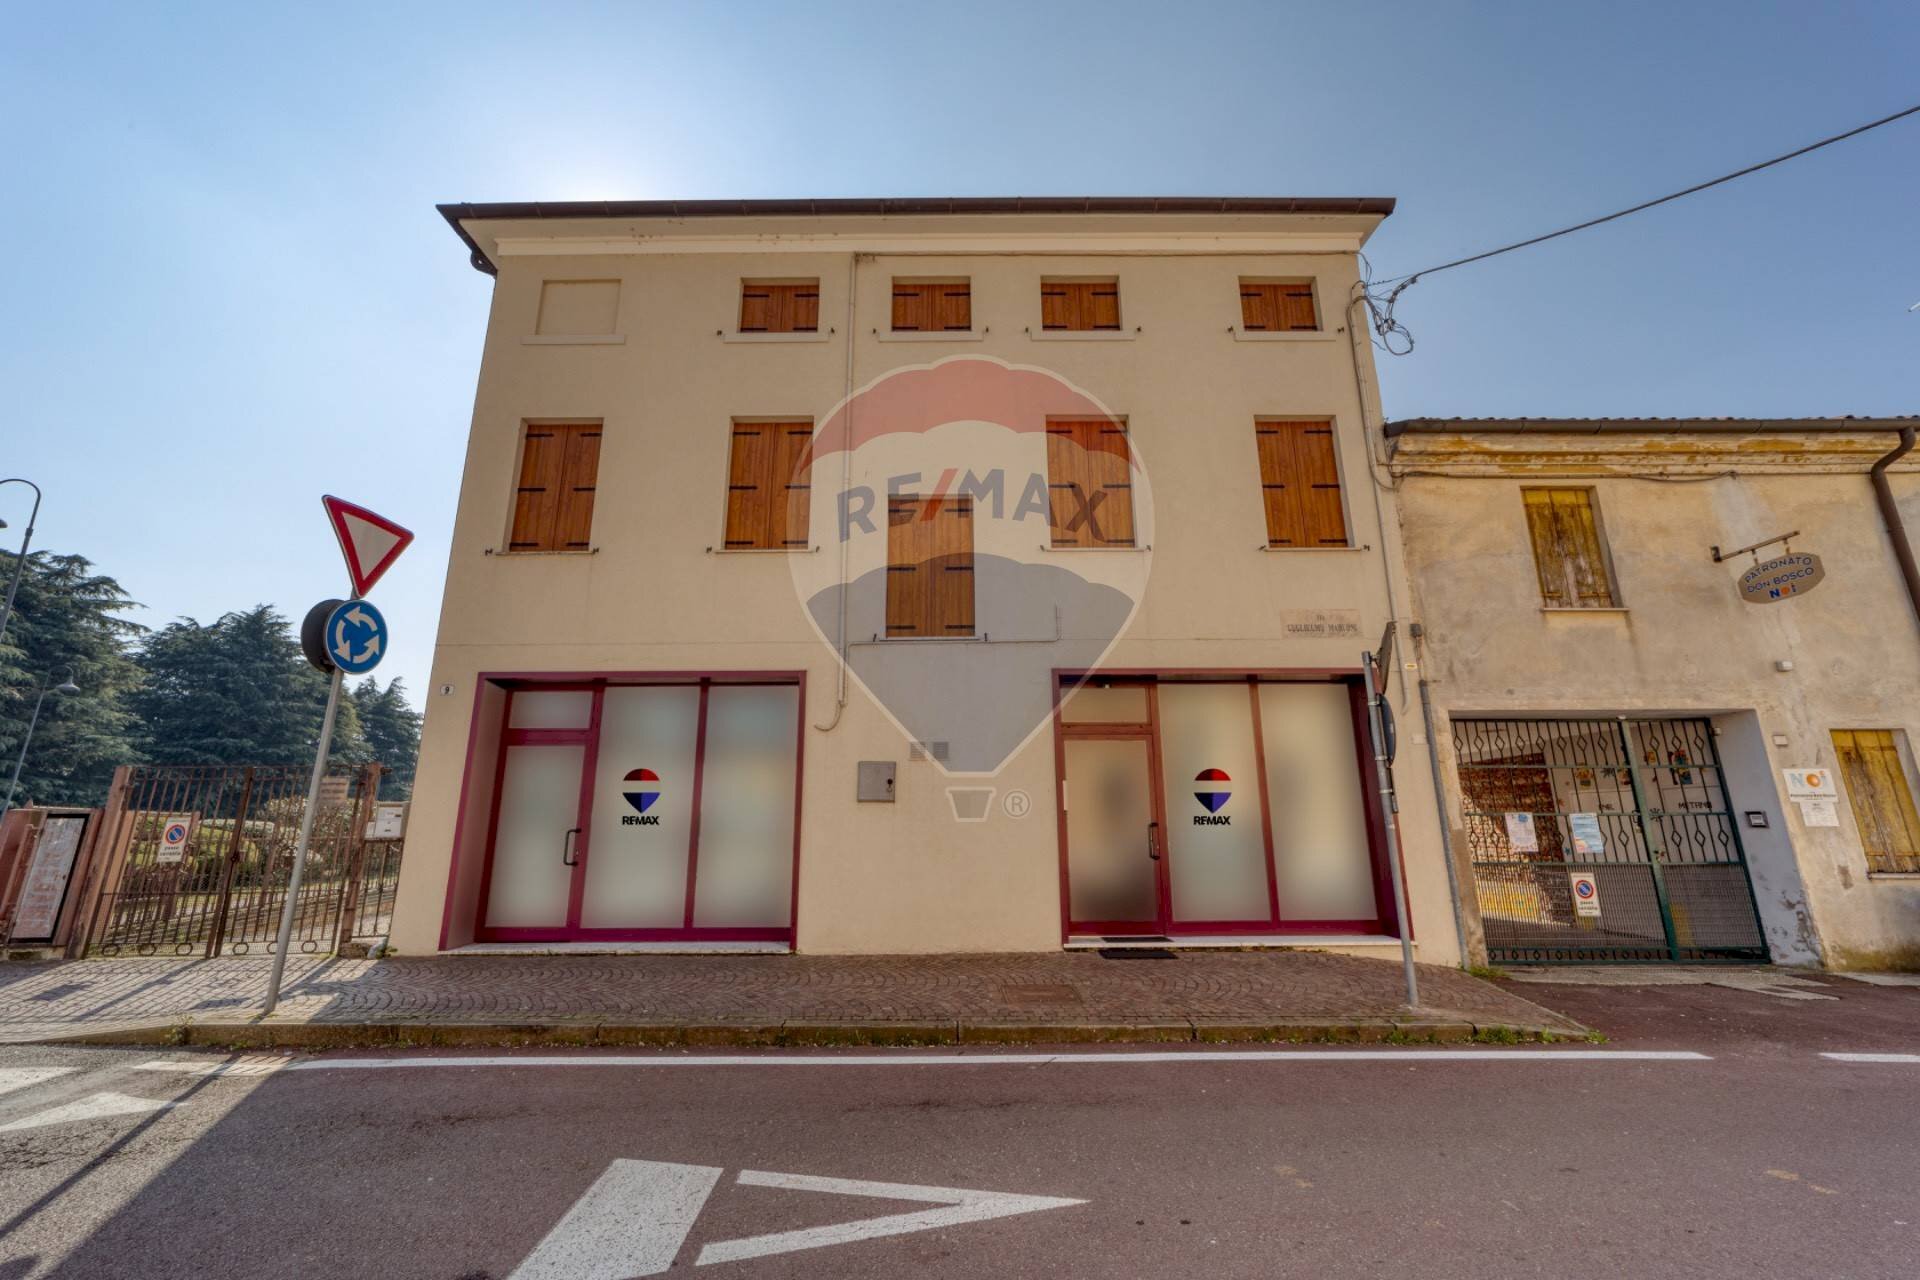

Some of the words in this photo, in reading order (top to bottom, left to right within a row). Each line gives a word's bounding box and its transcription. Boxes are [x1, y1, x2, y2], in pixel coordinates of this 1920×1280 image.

[1745, 557, 1812, 583] PATRONATO
[1747, 580, 1770, 593] DON
[1773, 567, 1814, 585] BOSCO
[622, 815, 660, 826] REMAX
[1193, 815, 1231, 826] REMAX
